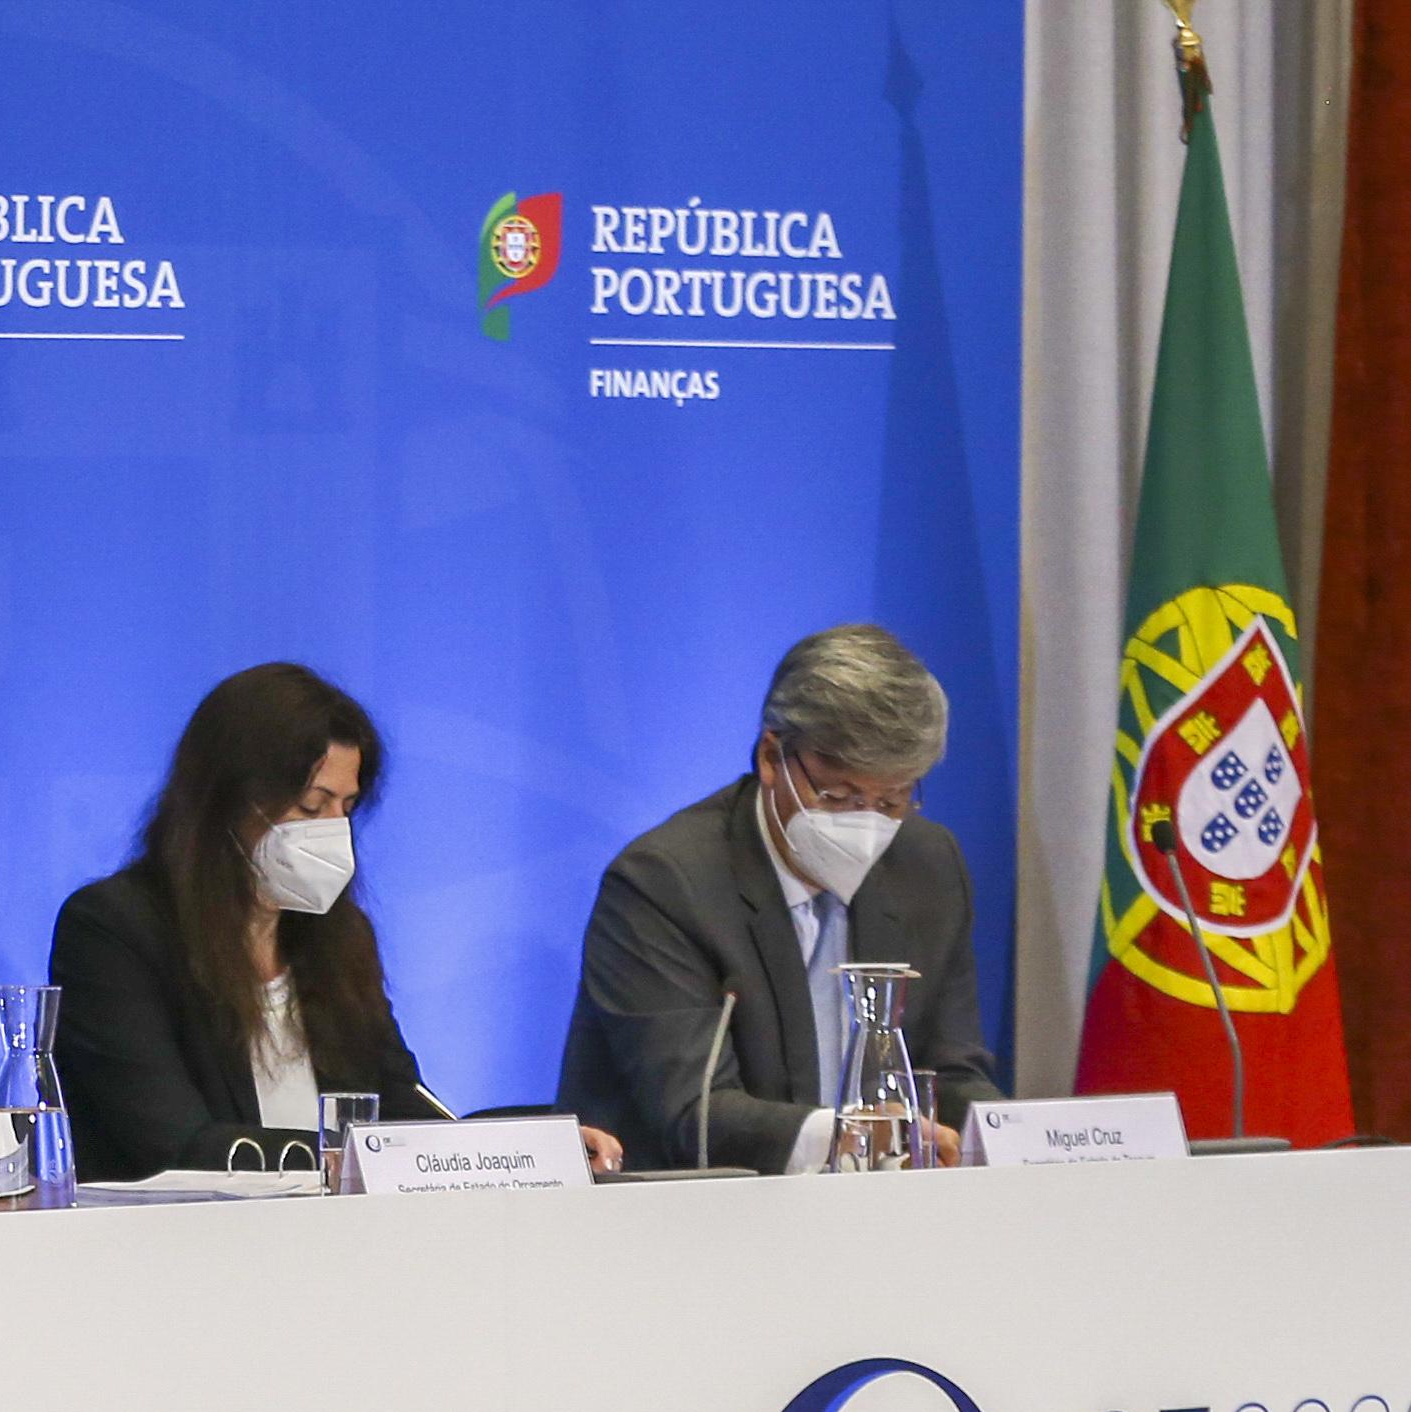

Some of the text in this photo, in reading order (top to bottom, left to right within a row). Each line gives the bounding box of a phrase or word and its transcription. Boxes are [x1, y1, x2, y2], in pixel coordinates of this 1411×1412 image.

[591, 197, 842, 258] REPÚBLICA
[590, 267, 897, 320] PORTUGUESA
[589, 369, 720, 407] FINANÇAS
[1046, 1127, 1123, 1151] Miguel Cruz
[416, 1151, 535, 1173] Cláudia Joaquim
